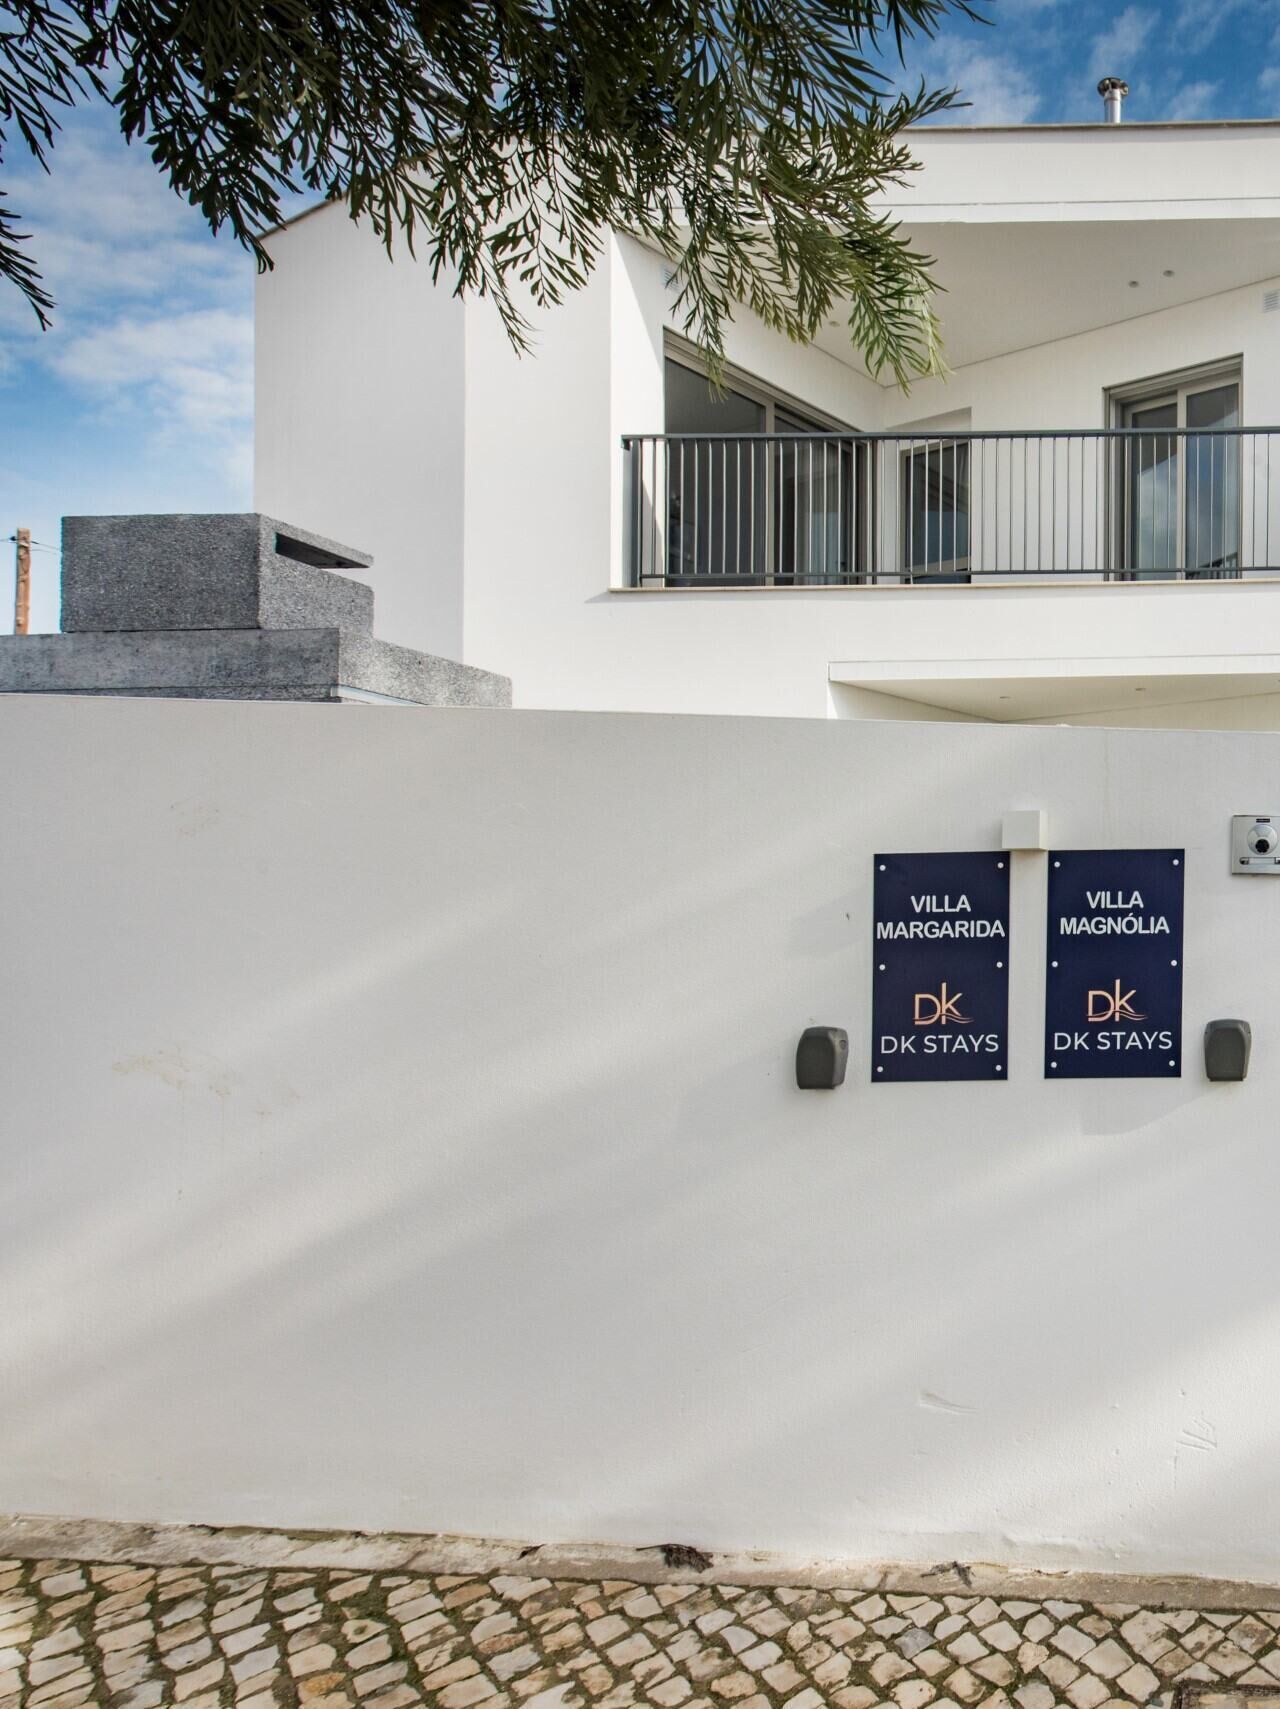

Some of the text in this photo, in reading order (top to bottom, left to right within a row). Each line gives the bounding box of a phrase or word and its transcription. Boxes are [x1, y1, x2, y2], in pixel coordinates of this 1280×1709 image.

[910, 894, 972, 914] VILLA
[1086, 890, 1144, 909] VILLA
[877, 920, 1006, 940] MARGARIDA
[1060, 912, 1170, 935] MAGNÓLIA
[880, 1034, 999, 1054] DK STAYS
[1054, 1031, 1173, 1051] DK STAYS
